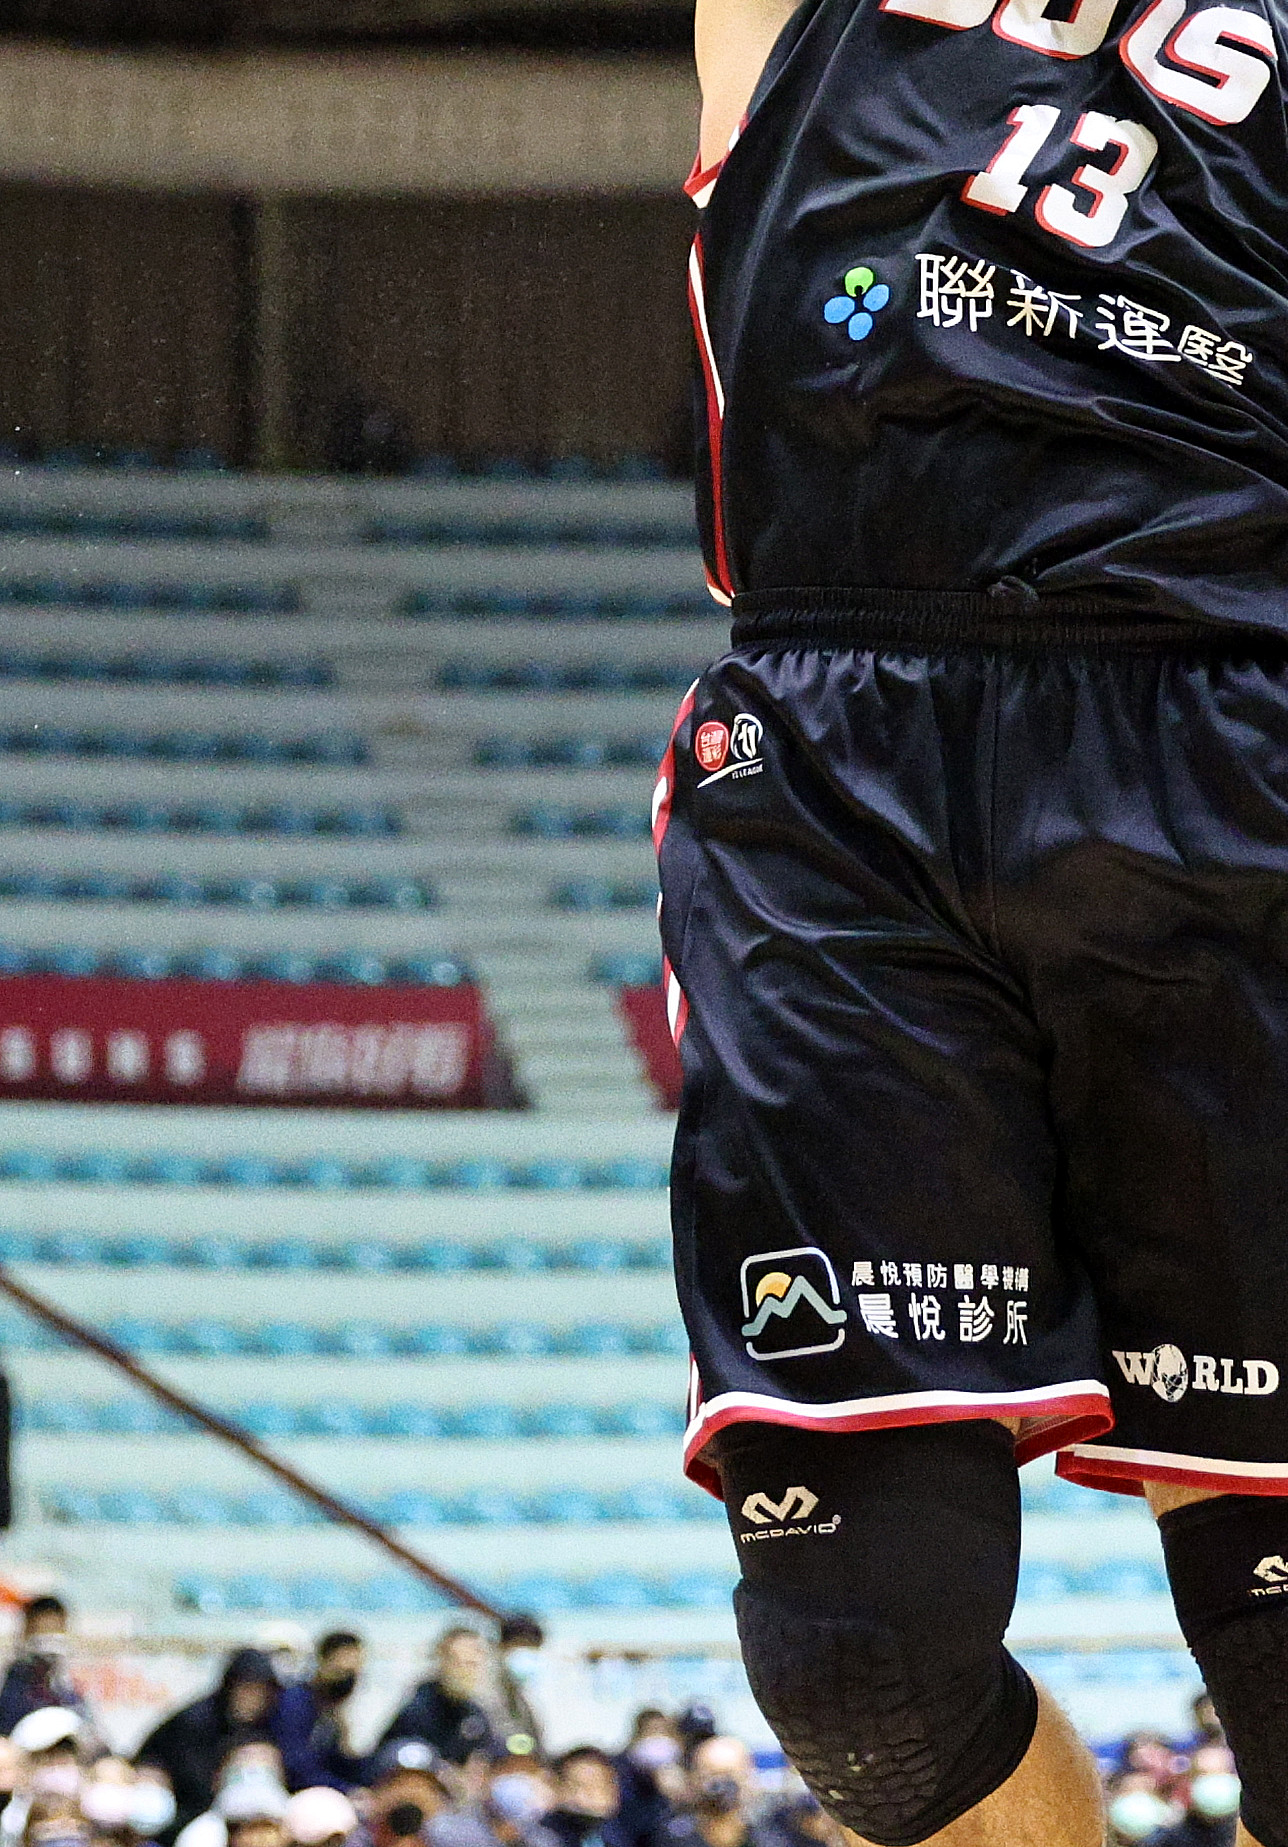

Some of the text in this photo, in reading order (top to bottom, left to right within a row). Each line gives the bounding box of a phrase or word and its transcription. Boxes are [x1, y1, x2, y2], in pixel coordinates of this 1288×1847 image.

[960, 104, 1158, 249] 13
[915, 253, 1253, 386] 聯新運醫
